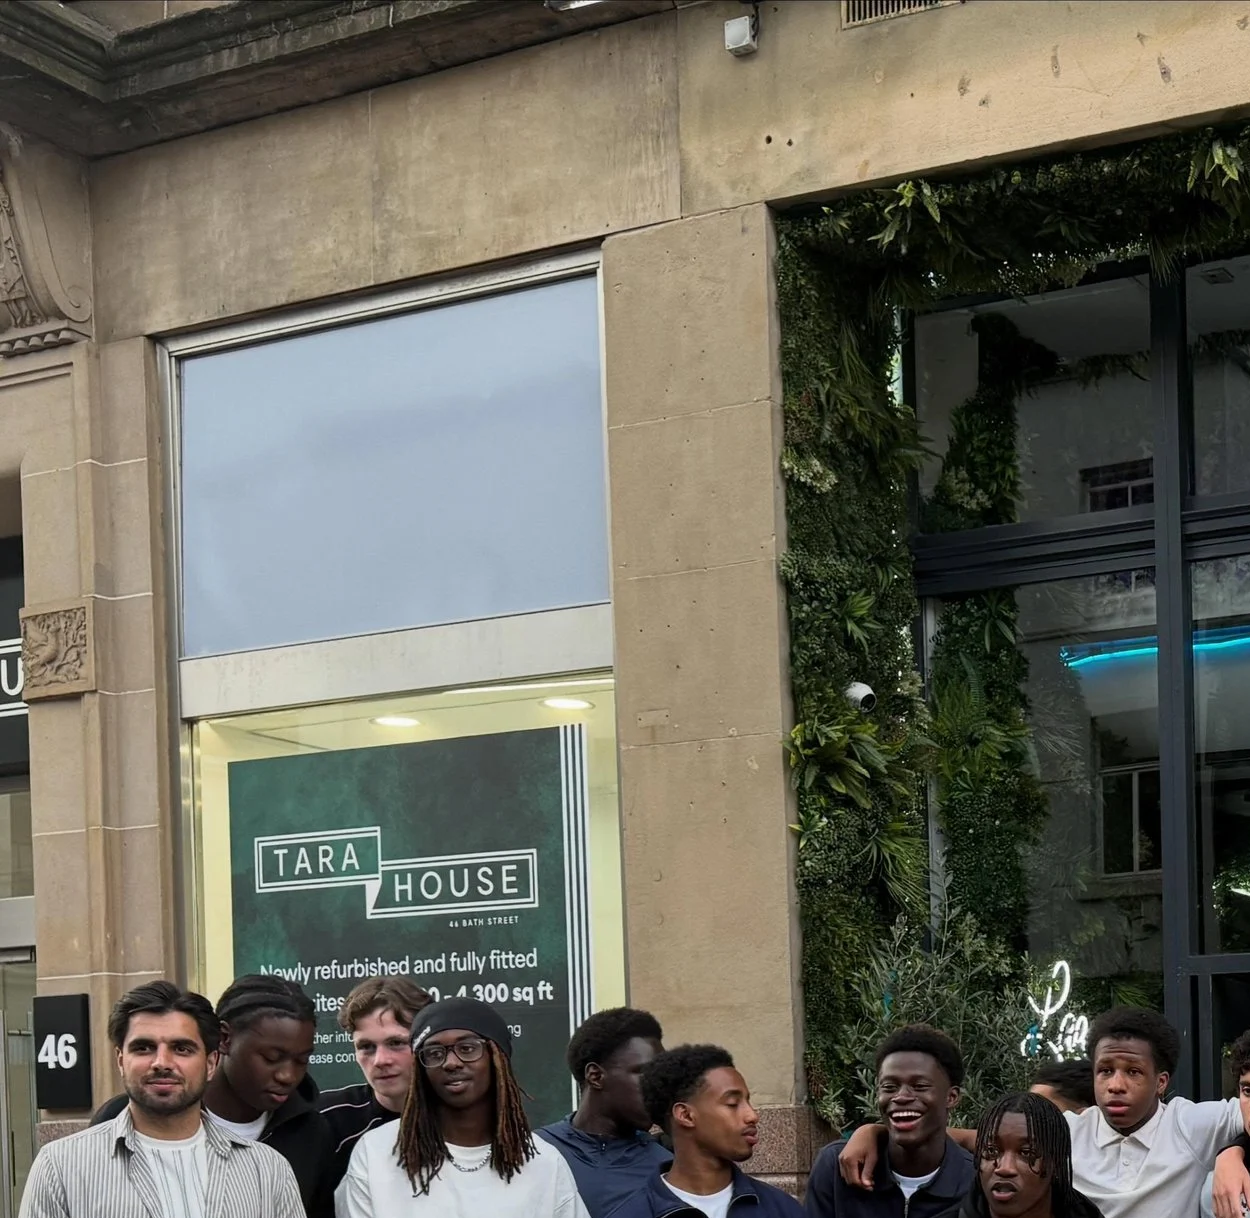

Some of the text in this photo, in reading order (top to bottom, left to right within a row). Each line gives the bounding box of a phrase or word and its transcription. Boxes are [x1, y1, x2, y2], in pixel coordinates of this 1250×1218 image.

[273, 842, 360, 877] TARA
[394, 864, 518, 902] HOUSE
[462, 918, 484, 927] BATH
[487, 915, 519, 926] STREET
[260, 947, 538, 986] Newly refurbished and fully fitted
[512, 986, 534, 1006] sq
[537, 980, 554, 1001] ft
[37, 1033, 77, 1069] 46
